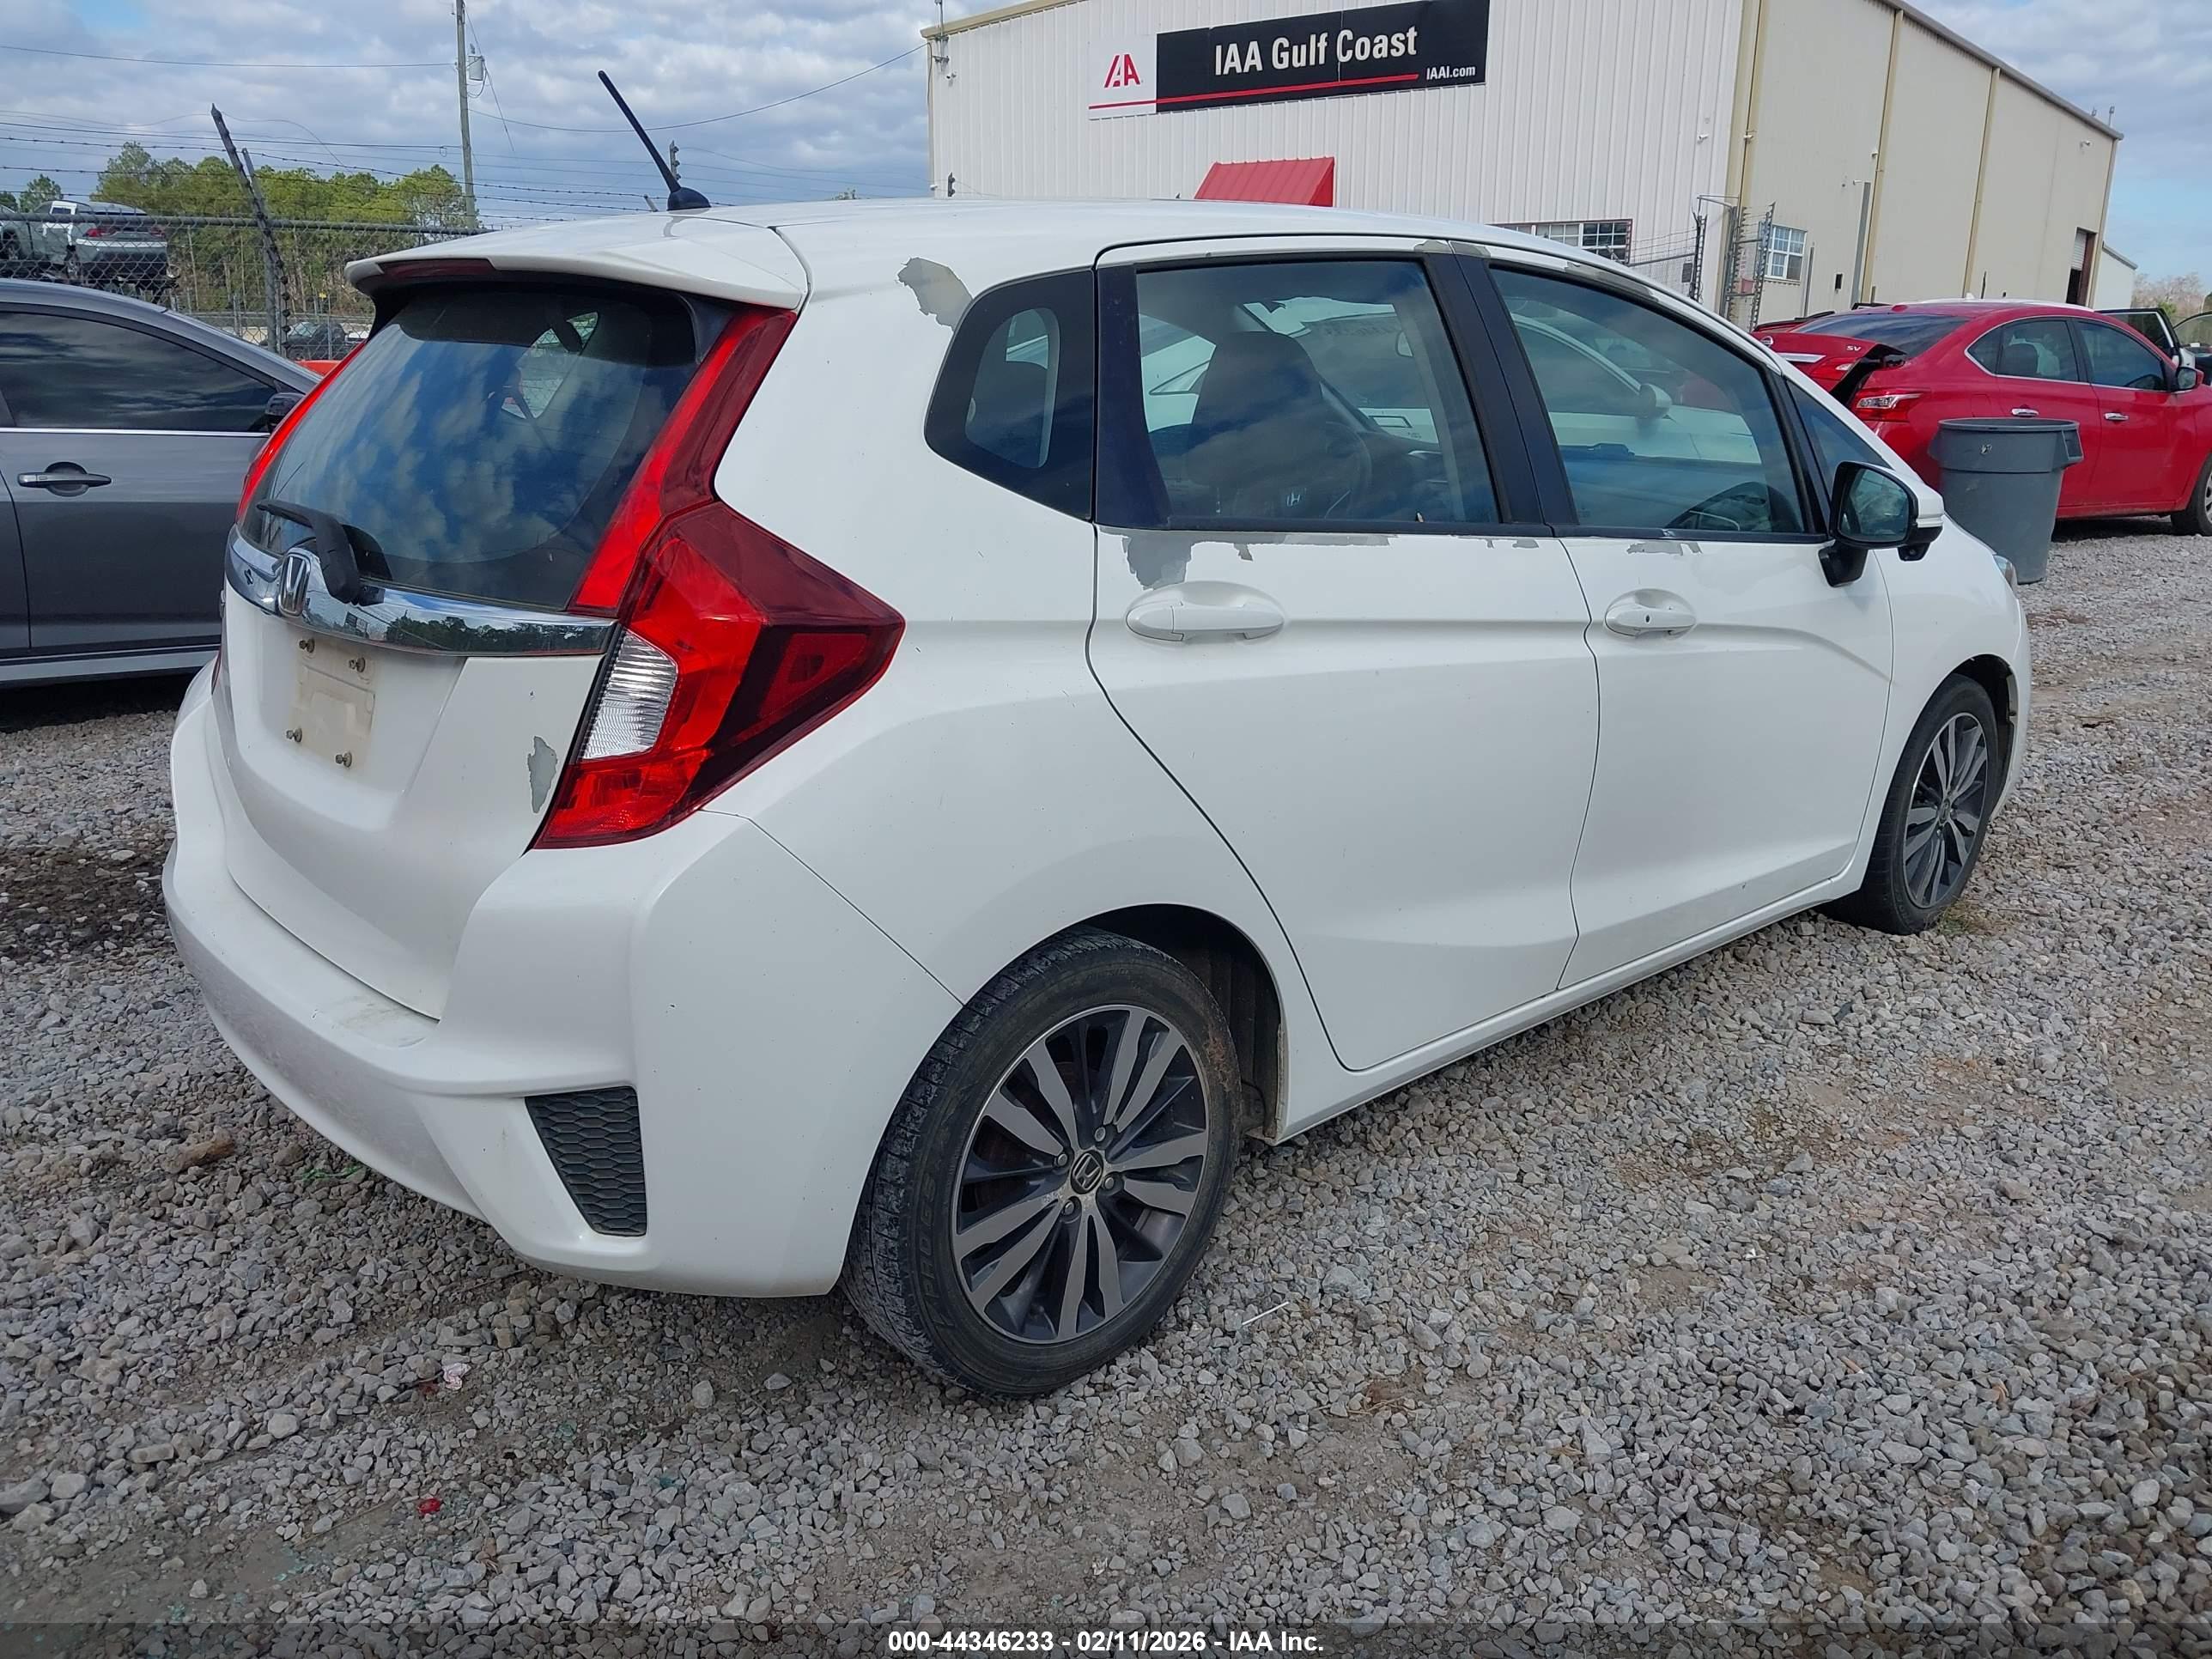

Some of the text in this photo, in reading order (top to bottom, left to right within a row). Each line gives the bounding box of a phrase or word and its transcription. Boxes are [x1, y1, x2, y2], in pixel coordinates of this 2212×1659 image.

[1215, 26, 1418, 76] IAA Gulf Coast
[1425, 65, 1476, 81] IAAI.com
